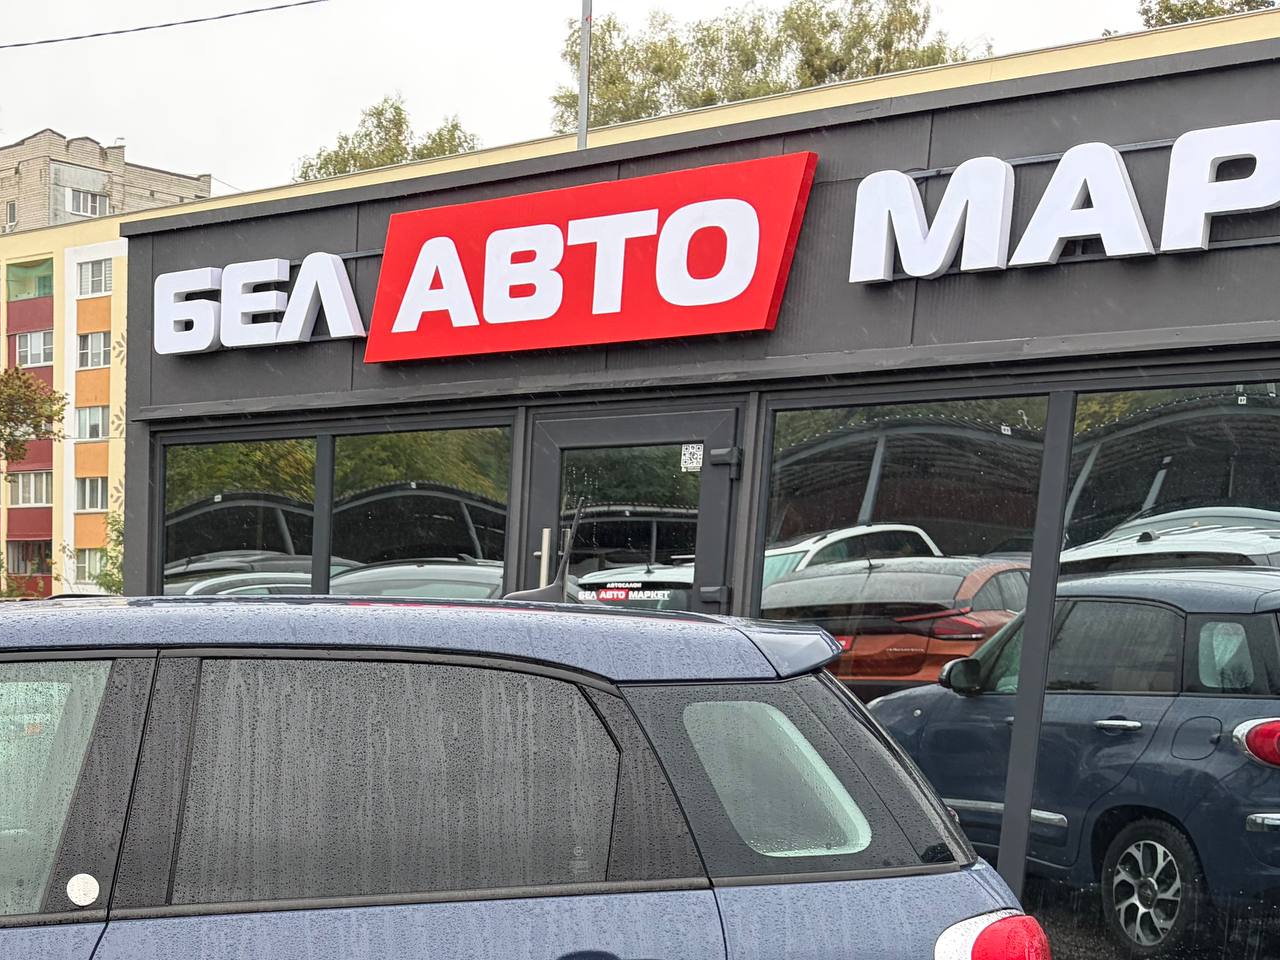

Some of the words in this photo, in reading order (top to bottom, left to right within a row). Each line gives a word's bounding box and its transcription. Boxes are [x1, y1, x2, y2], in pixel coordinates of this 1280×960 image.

[154, 252, 366, 355] БЕЛ
[391, 198, 761, 334] АВТО
[599, 590, 626, 598] АВТО
[628, 591, 670, 600] МАРКЕТ
